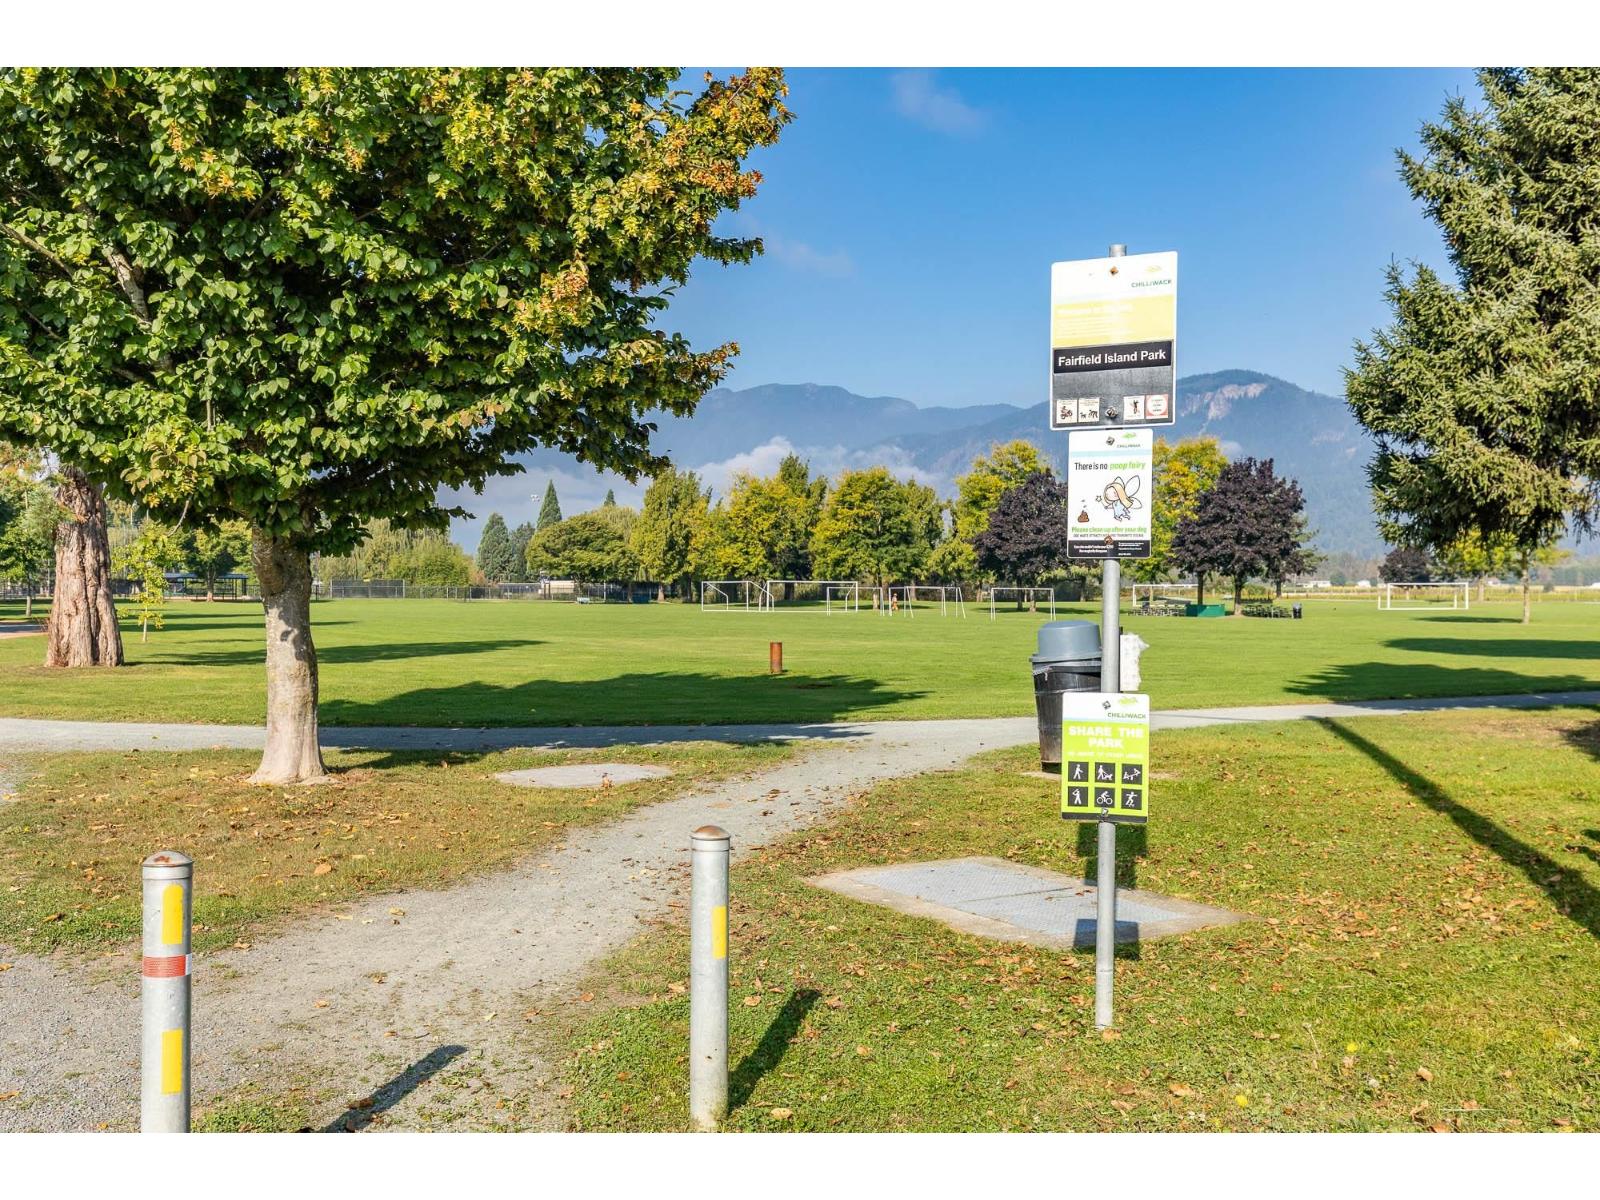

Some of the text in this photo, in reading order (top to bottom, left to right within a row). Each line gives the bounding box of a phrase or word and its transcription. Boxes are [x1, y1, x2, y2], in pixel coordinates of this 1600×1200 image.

[1058, 349, 1167, 367] Fairfield Island Park
[1075, 462, 1093, 471] There
[1093, 461, 1099, 470] is
[1109, 462, 1128, 471] poop
[1128, 461, 1146, 470] fairy
[1068, 726, 1144, 739] SHARE THE
[1088, 737, 1123, 749] PARK
